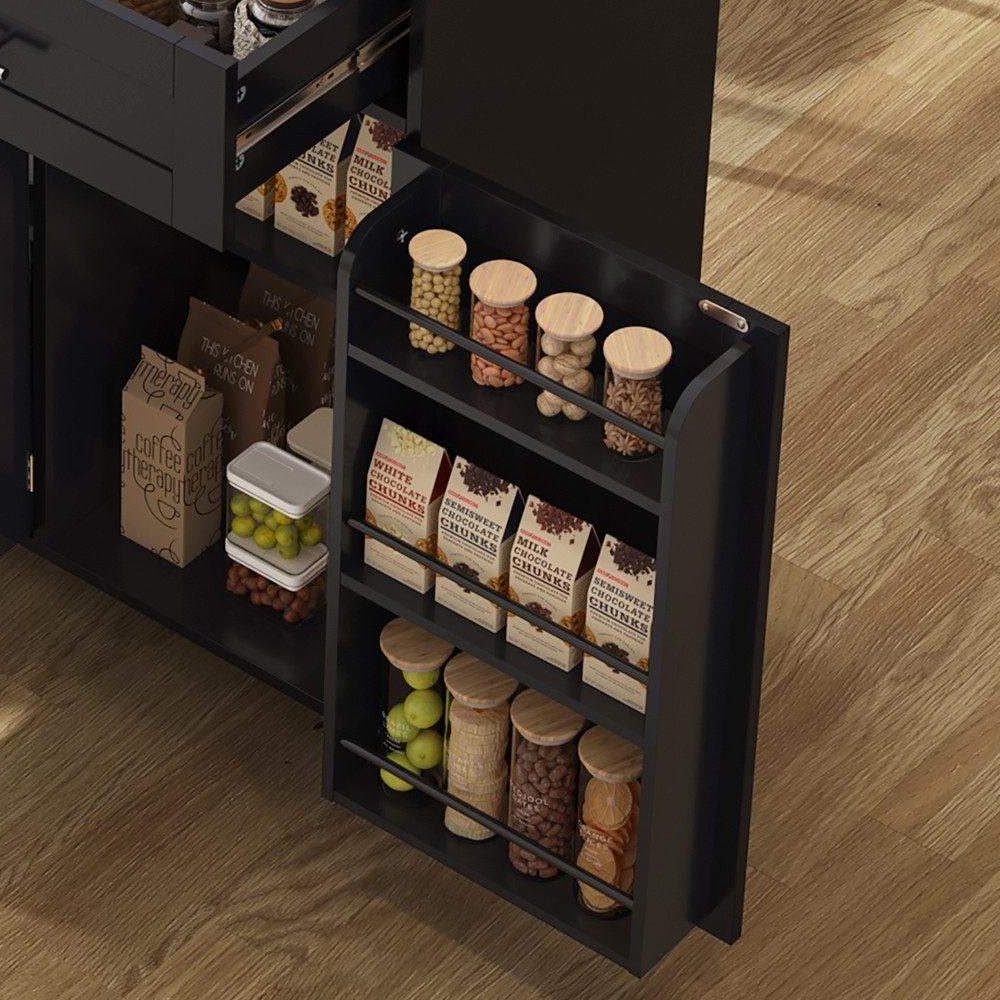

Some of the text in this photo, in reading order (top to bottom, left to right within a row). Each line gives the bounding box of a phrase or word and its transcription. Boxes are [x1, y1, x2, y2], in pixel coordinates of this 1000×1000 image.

[350, 165, 391, 191] CHOCOL
[353, 154, 385, 176] MILK
[349, 175, 388, 200] CHUN
[262, 290, 282, 311] THIS
[202, 336, 221, 358] THIS
[301, 330, 315, 346] ON
[213, 363, 238, 385] RUNS
[238, 377, 254, 394] ON
[136, 428, 182, 474] coffee
[124, 447, 181, 504] therapy
[370, 469, 428, 504] CHOCOLATE
[373, 458, 413, 486] WHITE
[369, 478, 425, 514] CHUNKS
[441, 507, 500, 543] CHOCOLATE
[444, 497, 503, 532] SEMISWEET
[440, 517, 497, 553] CHUNKS
[517, 535, 549, 558] MILK
[512, 556, 571, 592] CHUNKS
[514, 546, 574, 581] CHOCOLATE
[590, 586, 651, 623] CHOCOLATE
[594, 576, 654, 612] SEMISWEET
[589, 596, 648, 634] CHUNKS
